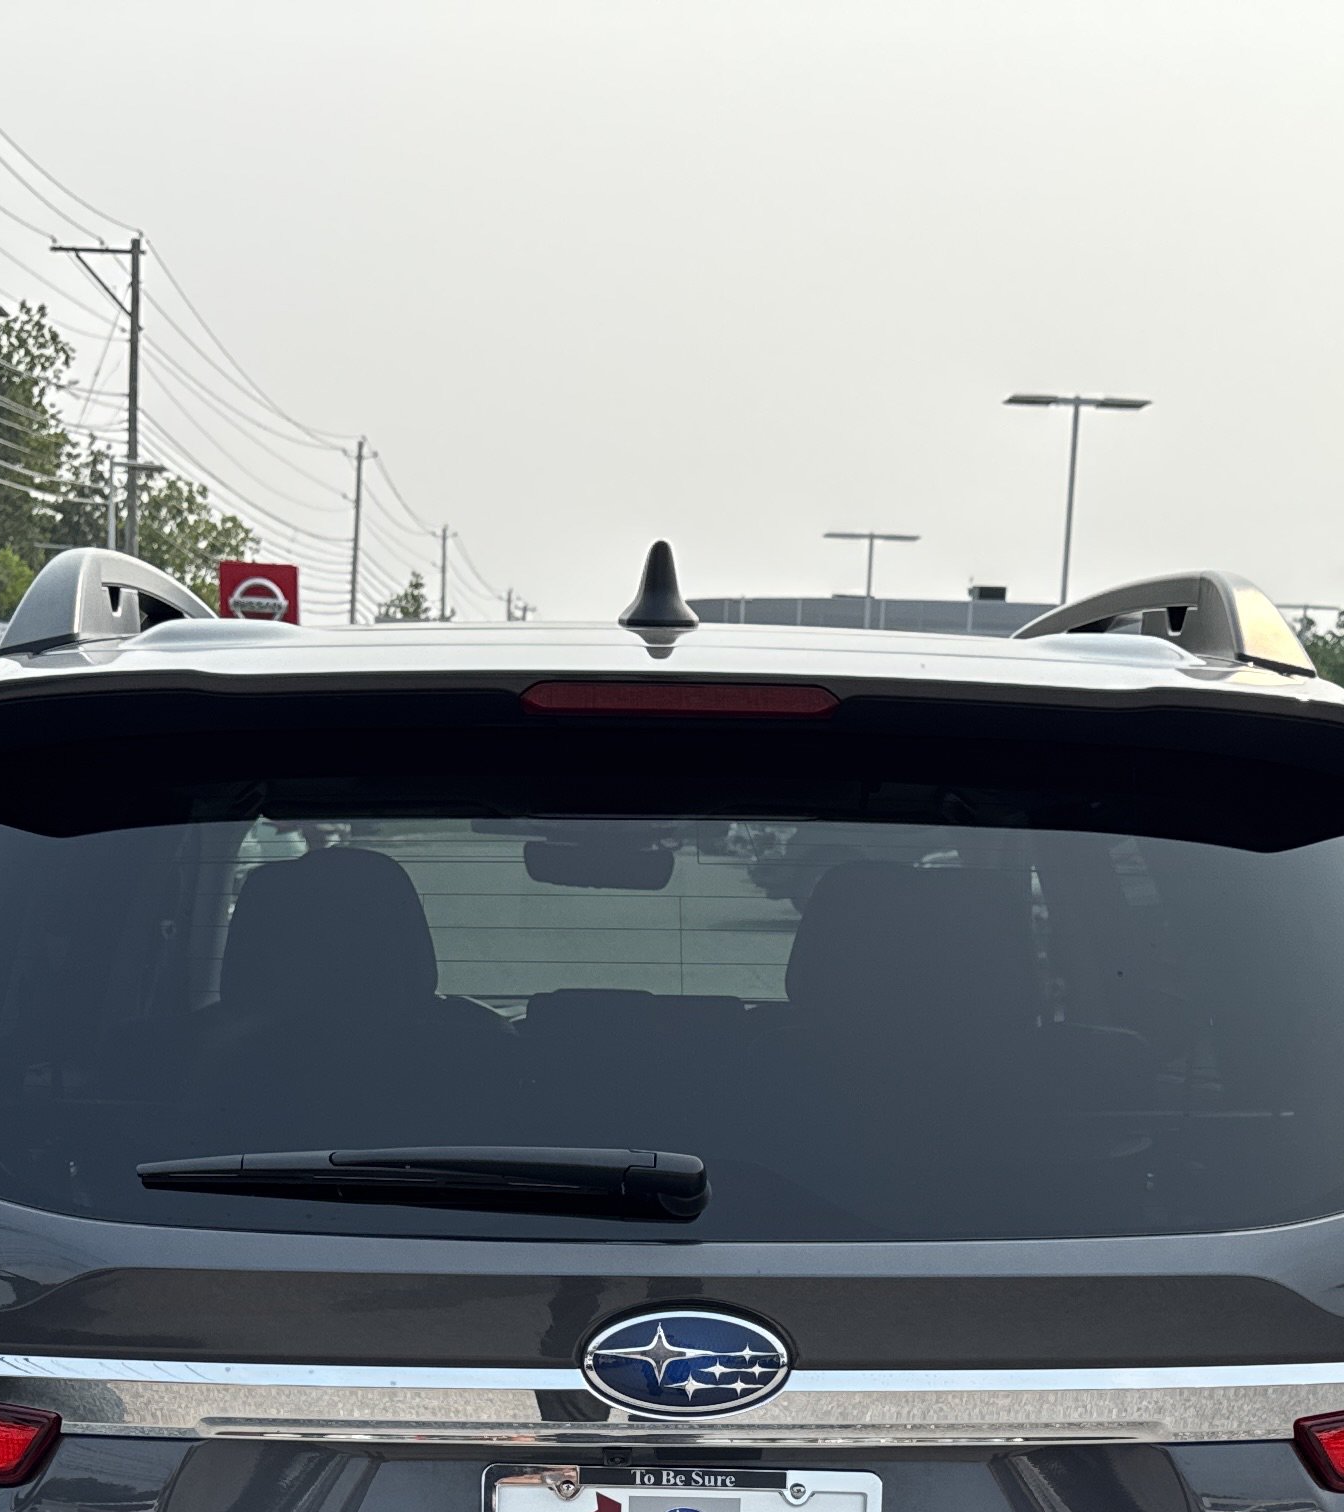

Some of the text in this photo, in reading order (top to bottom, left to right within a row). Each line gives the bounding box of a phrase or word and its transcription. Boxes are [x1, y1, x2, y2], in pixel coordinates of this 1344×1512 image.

[630, 1469, 736, 1487] To Be Sure
